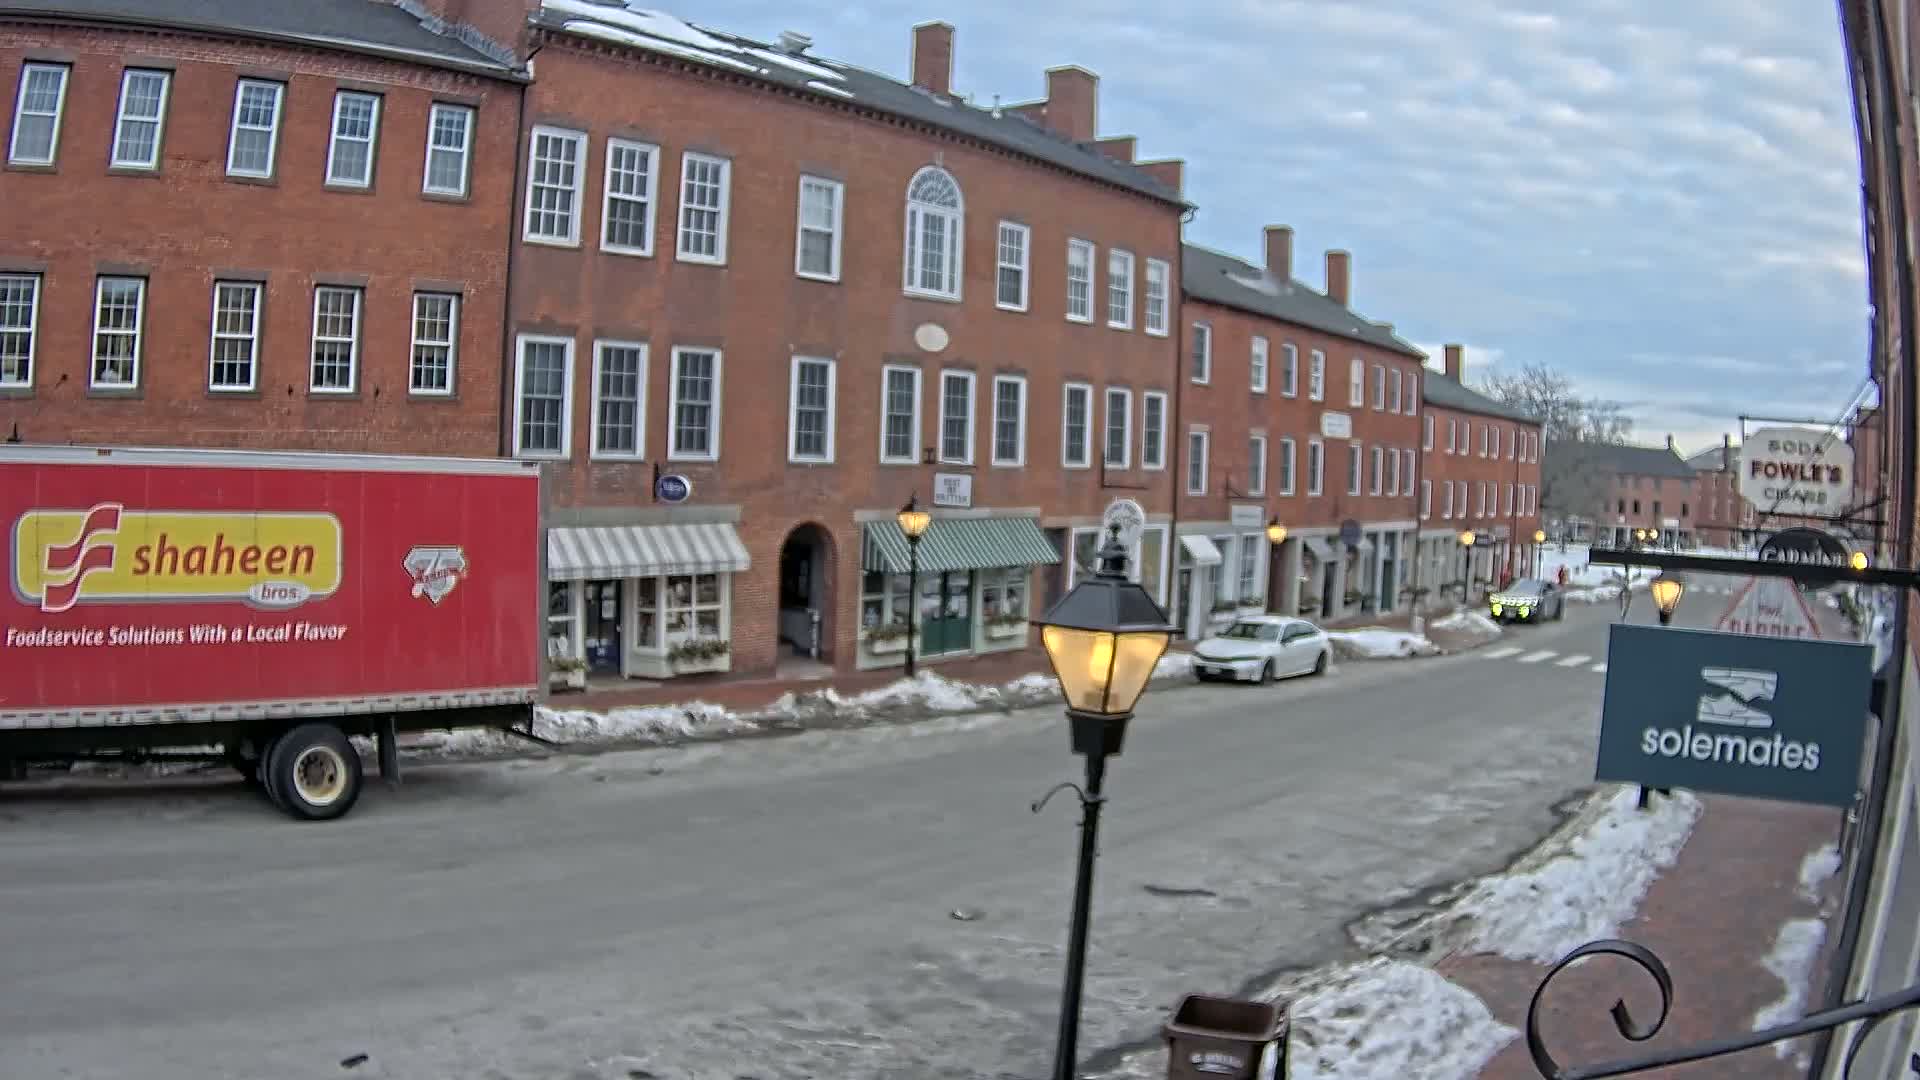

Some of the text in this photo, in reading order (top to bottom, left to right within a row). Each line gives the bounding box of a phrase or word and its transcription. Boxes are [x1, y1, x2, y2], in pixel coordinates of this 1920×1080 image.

[1768, 440, 1824, 456] SODA
[1751, 461, 1842, 484] FOWLE'S
[132, 533, 315, 575] shaheen
[7, 620, 347, 647] Foodservice Solutions With a Local Flavor
[1641, 724, 1820, 771] solemates
